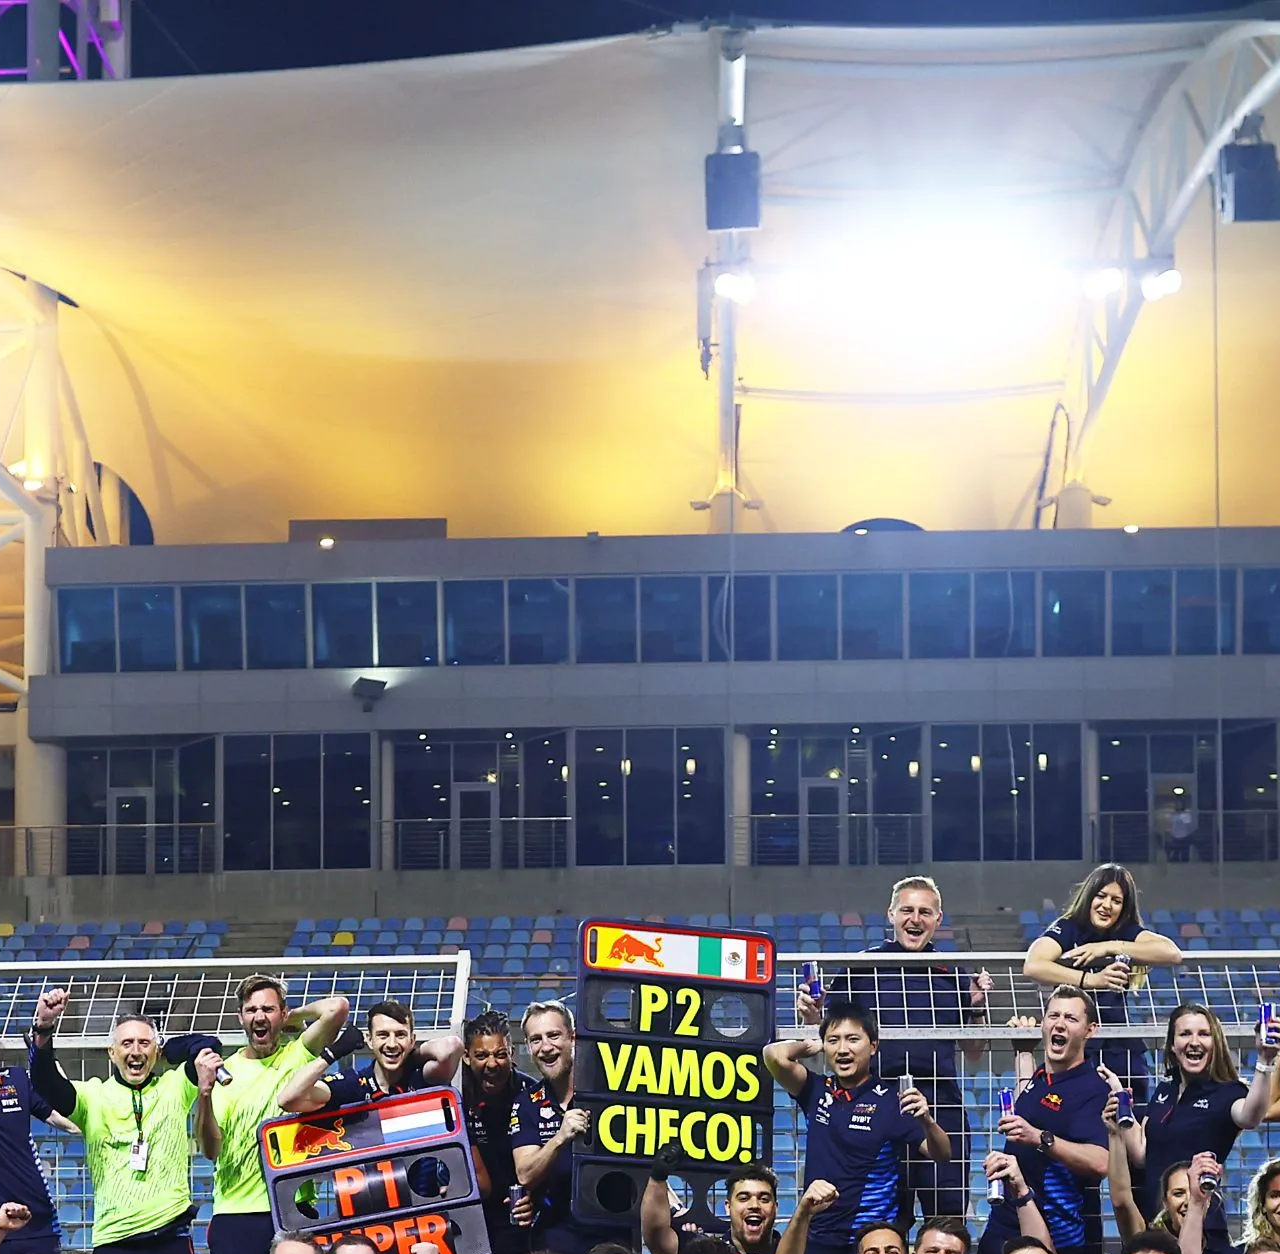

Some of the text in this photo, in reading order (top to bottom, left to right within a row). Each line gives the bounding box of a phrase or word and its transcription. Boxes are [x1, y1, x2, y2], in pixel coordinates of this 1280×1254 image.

[640, 984, 701, 1036] P2
[597, 1041, 759, 1102] VAMOS
[852, 1115, 871, 1123] BYBIT
[335, 1160, 400, 1217] P1
